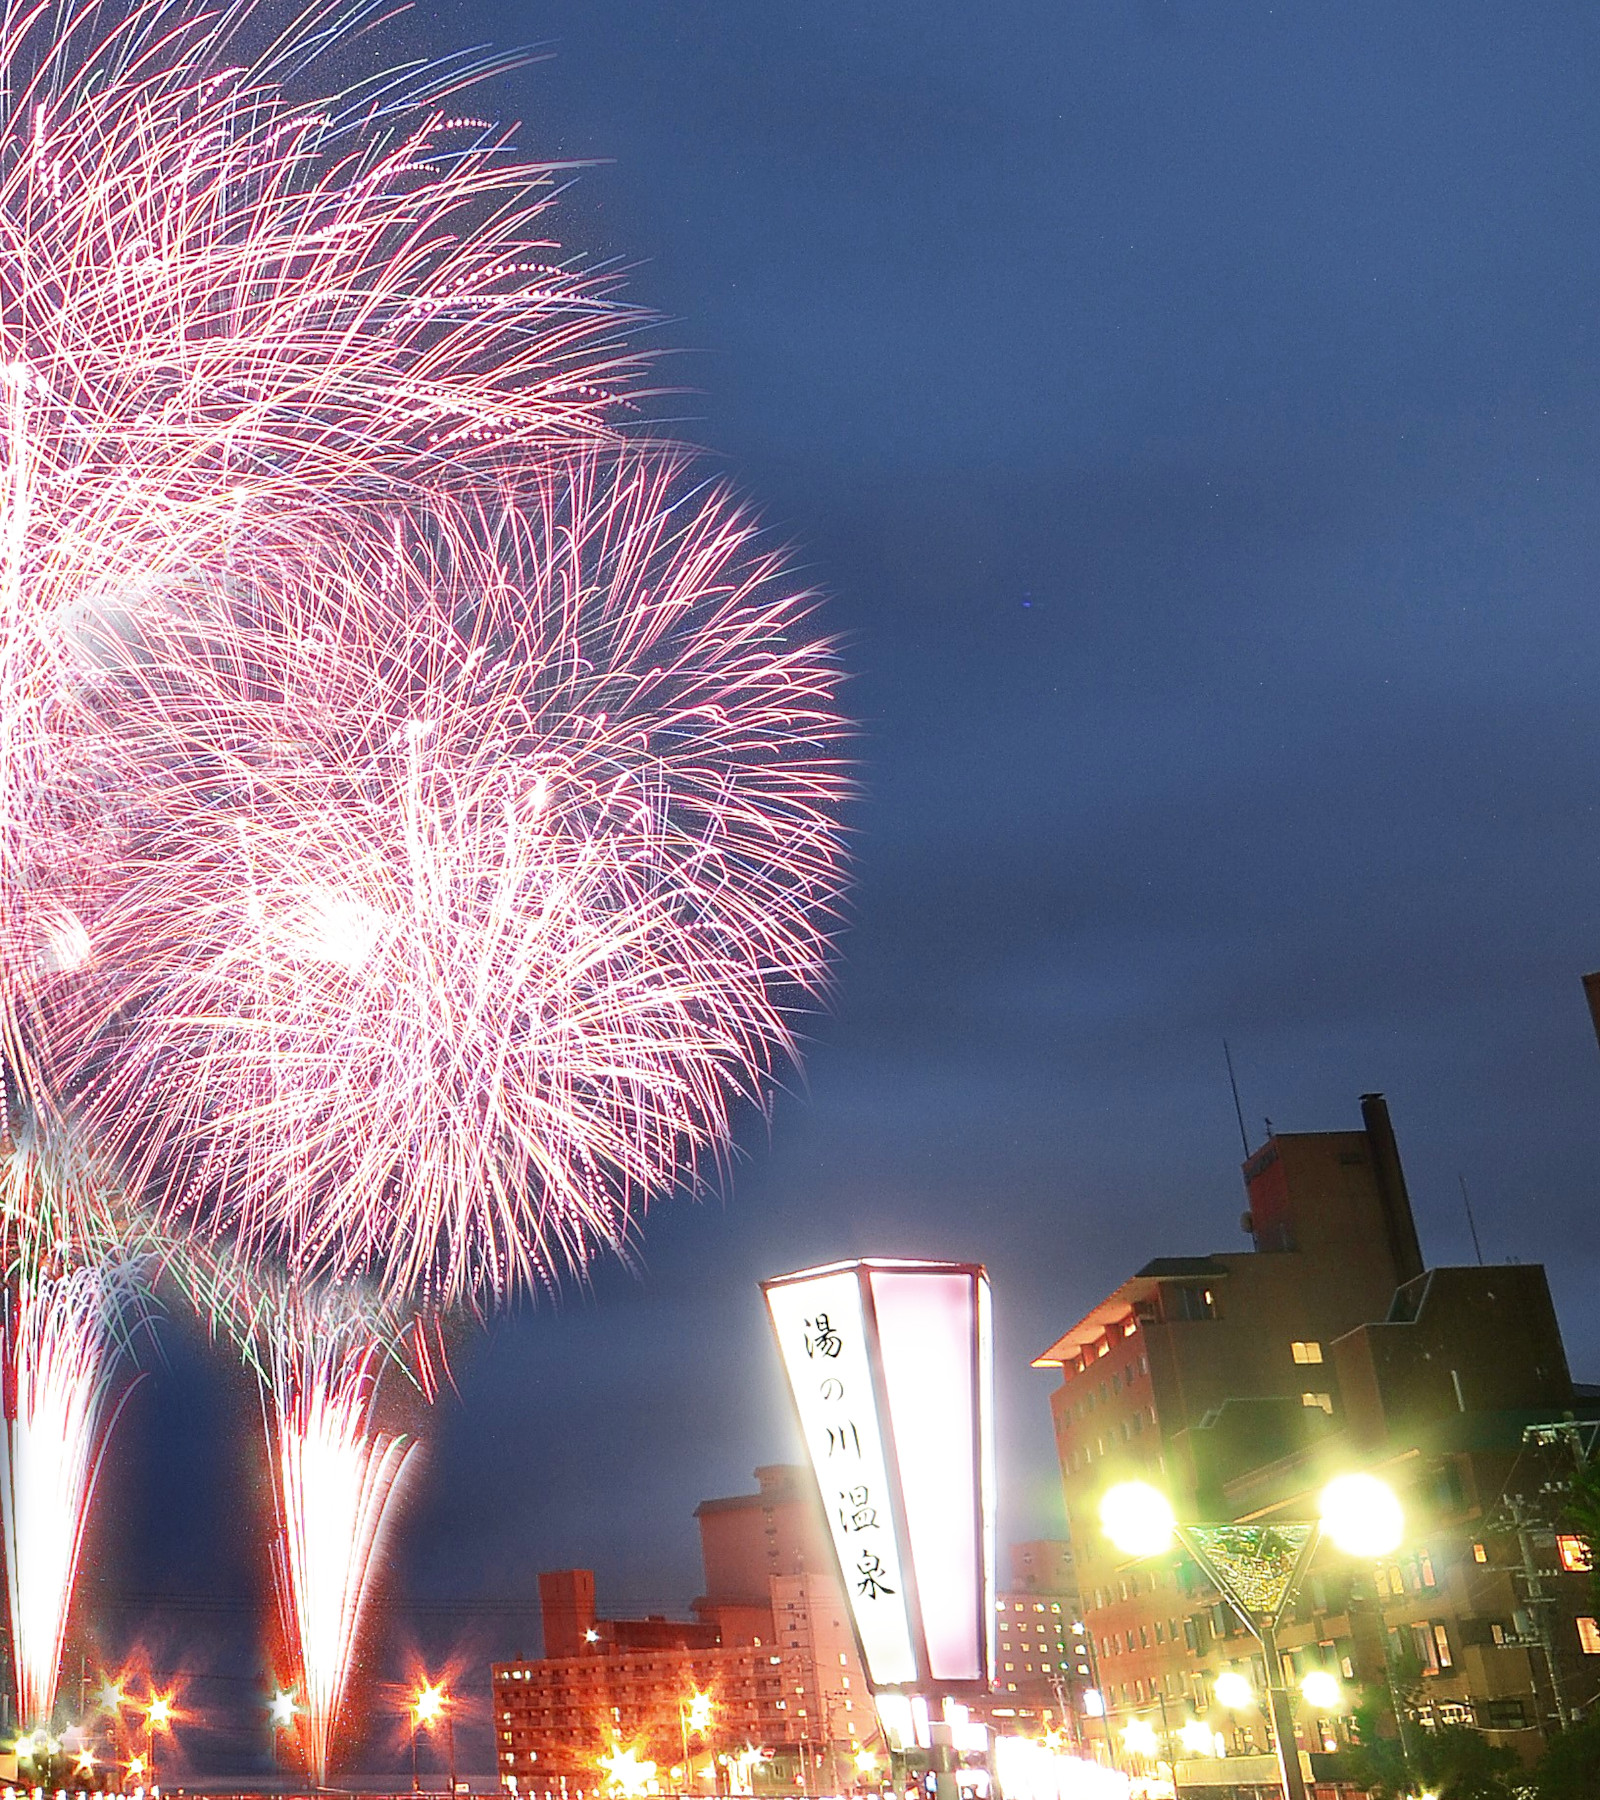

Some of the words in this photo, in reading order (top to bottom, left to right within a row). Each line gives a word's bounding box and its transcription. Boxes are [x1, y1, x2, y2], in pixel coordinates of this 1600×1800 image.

[803, 1313, 896, 1600] 湯の川温泉
